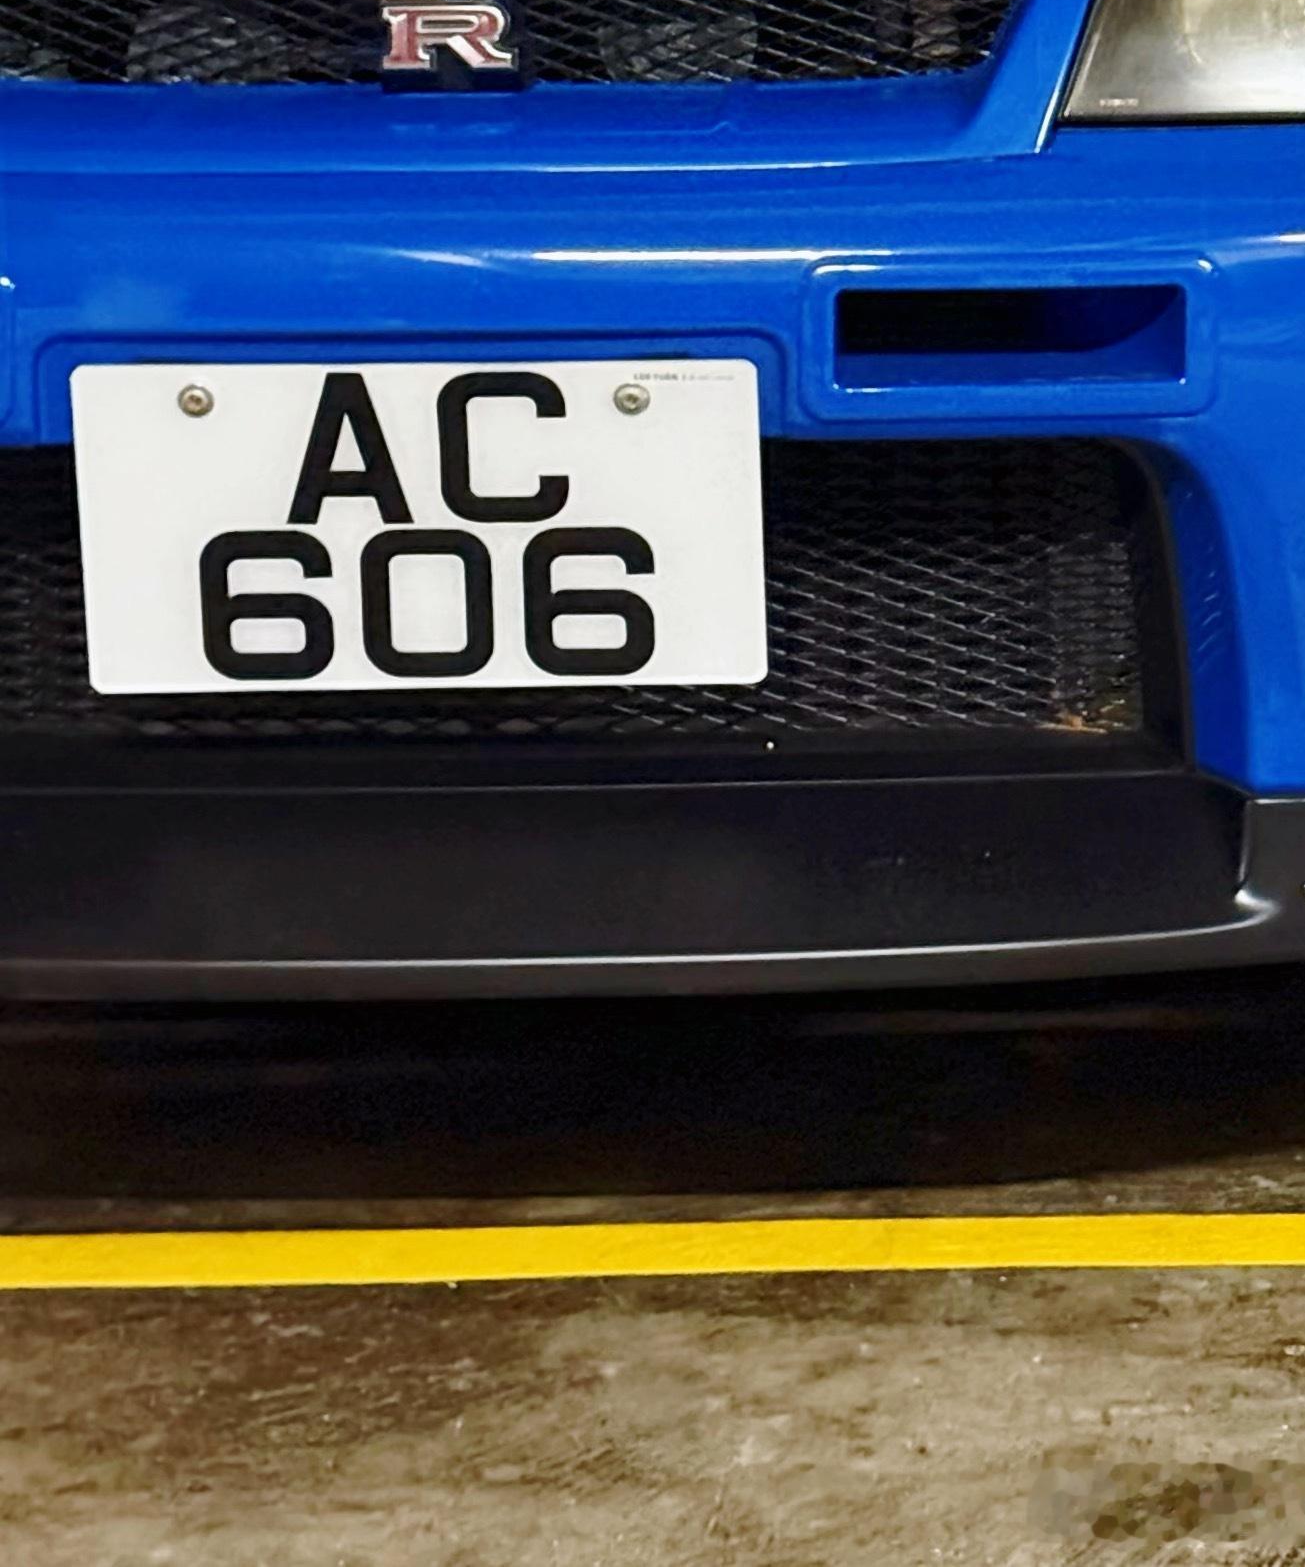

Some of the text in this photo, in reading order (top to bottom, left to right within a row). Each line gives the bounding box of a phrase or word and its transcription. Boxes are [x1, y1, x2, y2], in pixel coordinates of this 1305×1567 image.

[382, 5, 517, 69] R
[286, 371, 569, 525] AC
[199, 526, 656, 681] 606
